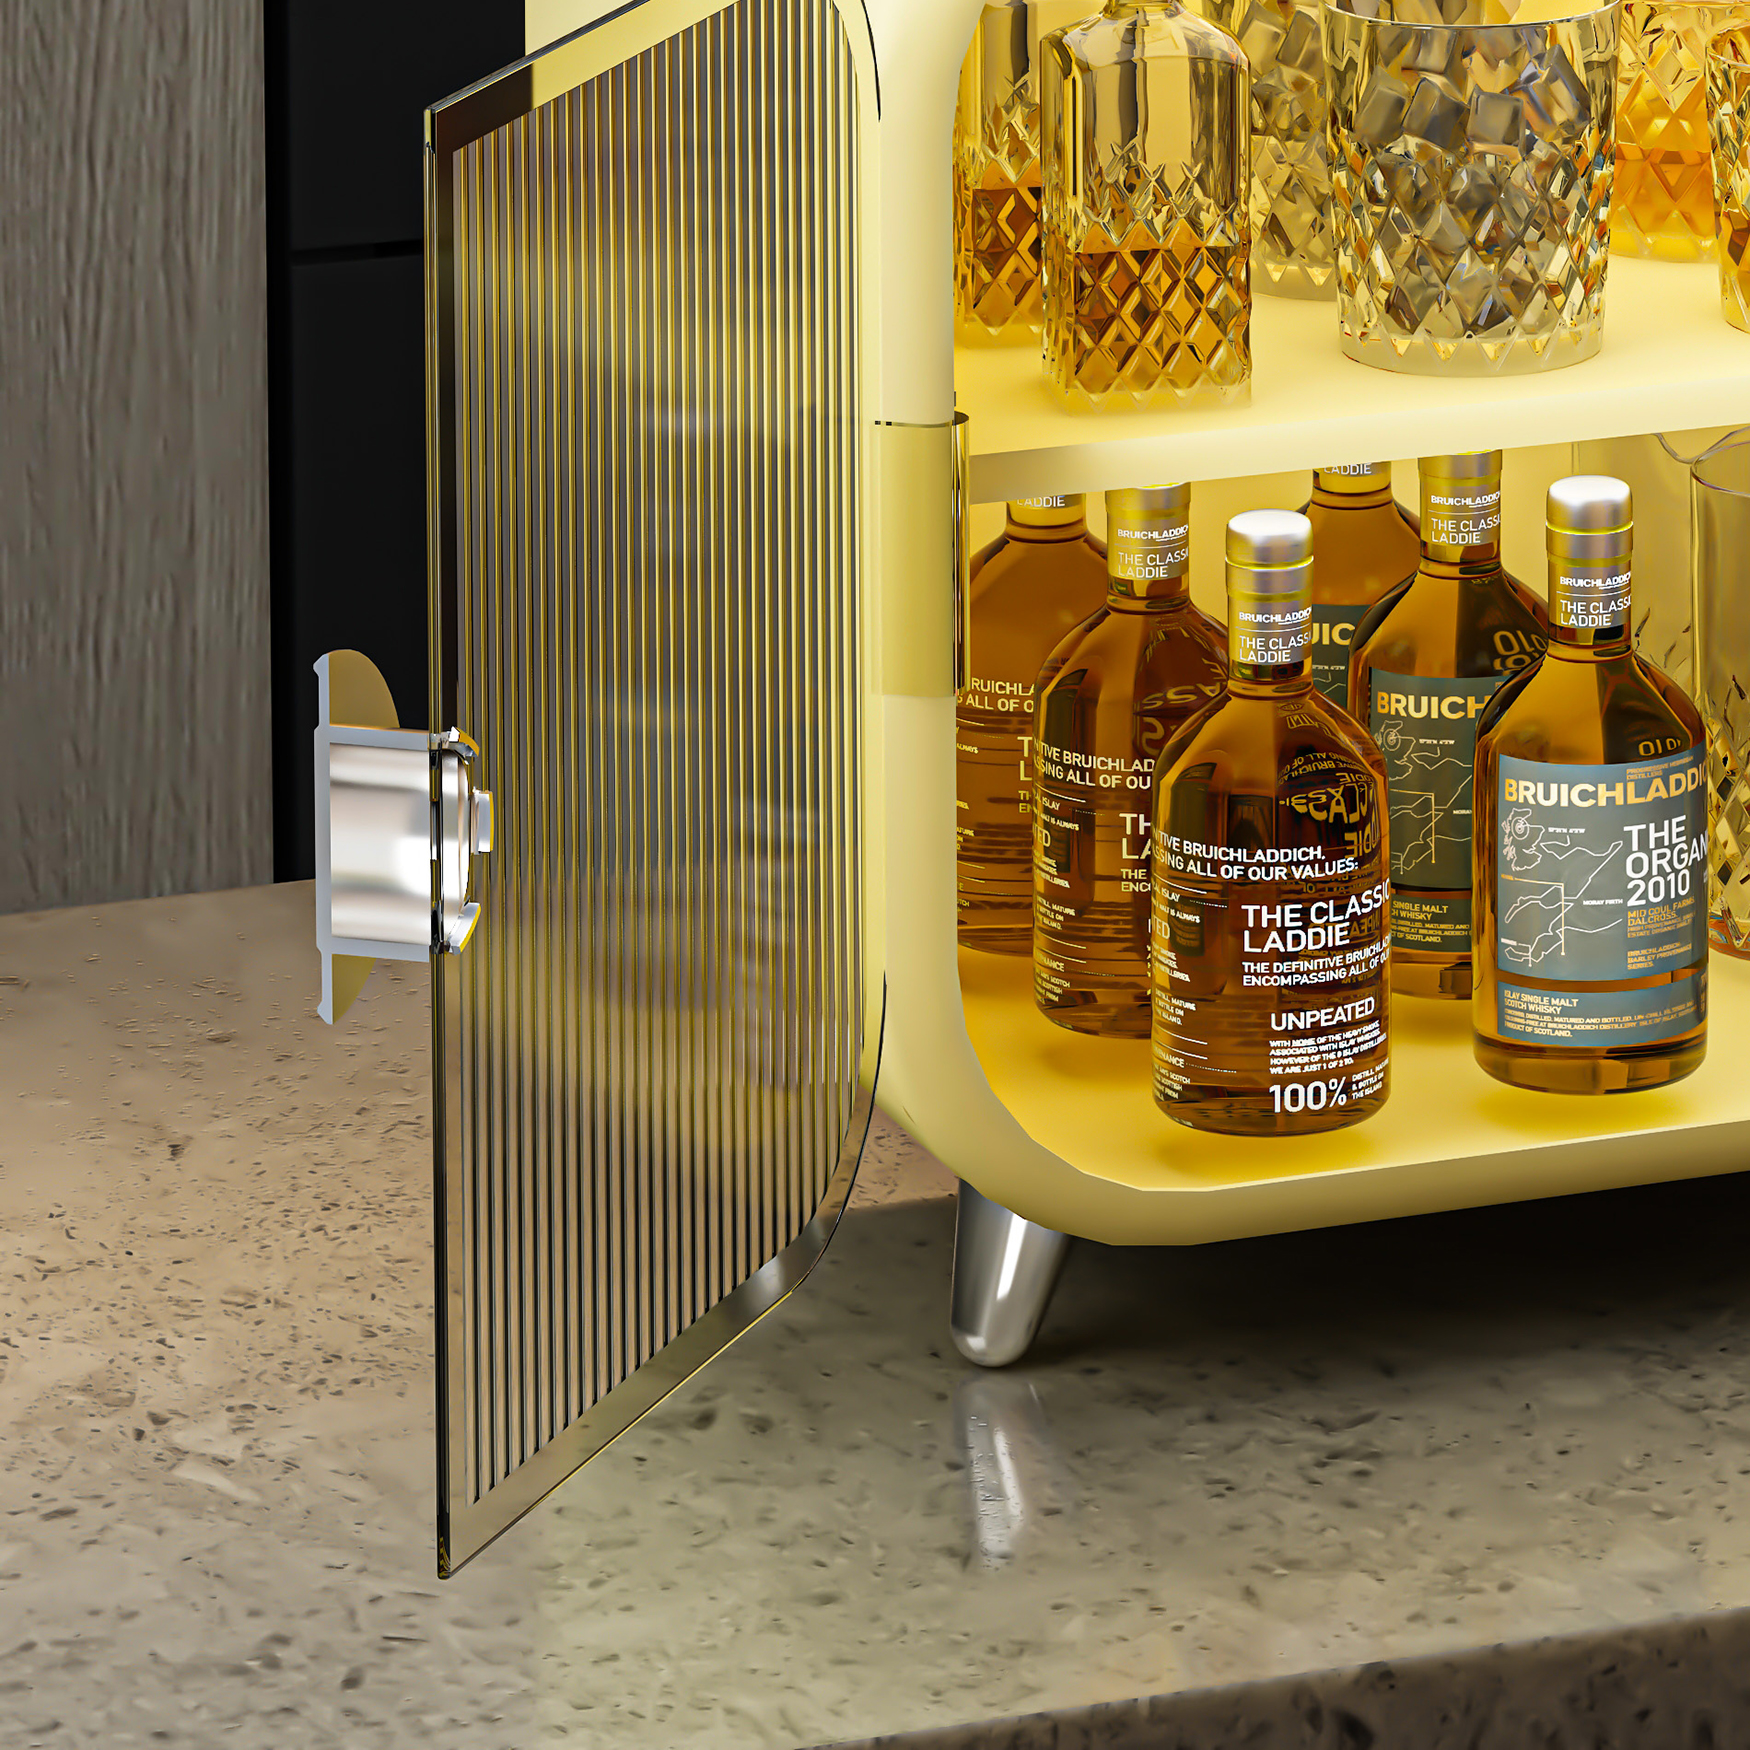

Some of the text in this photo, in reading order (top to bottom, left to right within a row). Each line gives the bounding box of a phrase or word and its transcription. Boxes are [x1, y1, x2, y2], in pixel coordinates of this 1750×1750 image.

[1324, 463, 1372, 475] LADDIE
[1016, 495, 1065, 508] LADDIE
[1431, 518, 1457, 531] THE
[1432, 531, 1481, 544] LADDIE
[1118, 552, 1143, 565] THE
[1118, 565, 1168, 579] LADDIE
[1560, 599, 1587, 614] THE
[1561, 613, 1611, 627] LADDIE
[1239, 635, 1266, 650] THE
[1240, 649, 1291, 663] LADDIE
[966, 693, 1019, 712] ALL OF
[1067, 769, 1096, 787] ALL
[1099, 774, 1122, 789] OF
[1623, 814, 1687, 852] THE
[1183, 840, 1326, 863] BRUICHLADDICH.
[1121, 869, 1147, 880] THE
[1186, 857, 1359, 881] ALL OF OUR VALUES:
[1162, 888, 1181, 902] ISLAY
[1626, 868, 1690, 908] 2010
[1241, 877, 1390, 928] THE CLASSIC
[1393, 901, 1449, 913] SINGLE MALT
[1400, 910, 1432, 921] WHISKY
[1627, 910, 1646, 918] MID
[1648, 904, 1672, 916] COUL
[1243, 922, 1350, 953] LADDIE
[1628, 930, 1650, 938] ESTATE
[1242, 954, 1344, 974] THE DEFINITIVE
[1627, 955, 1656, 964] BARLEY
[1243, 957, 1379, 986] ENCOMPASSING ALL OF
[1504, 989, 1579, 1007] ISLAY SINGLE MALT
[1271, 996, 1375, 1031] UNPEATED
[1505, 998, 1527, 1010] SCOTCH
[1528, 1003, 1562, 1014] WHISKY
[1547, 1022, 1598, 1030] BRUICHLADDICH
[1292, 1037, 1316, 1048] NONE
[1317, 1035, 1327, 1044] OF
[1327, 1033, 1342, 1043] THE
[1343, 1027, 1362, 1039] HEAVY
[1269, 1037, 1357, 1056] ASSOCIATED WITH ISLAY
[1270, 1045, 1360, 1065] HOWEVER OF THE ISLAY
[1284, 1066, 1301, 1074] ARE
[1303, 1064, 1320, 1072] JUST
[1328, 1061, 1339, 1069] OF
[1269, 1076, 1347, 1113] 100%
[1352, 1090, 1364, 1100] THE
